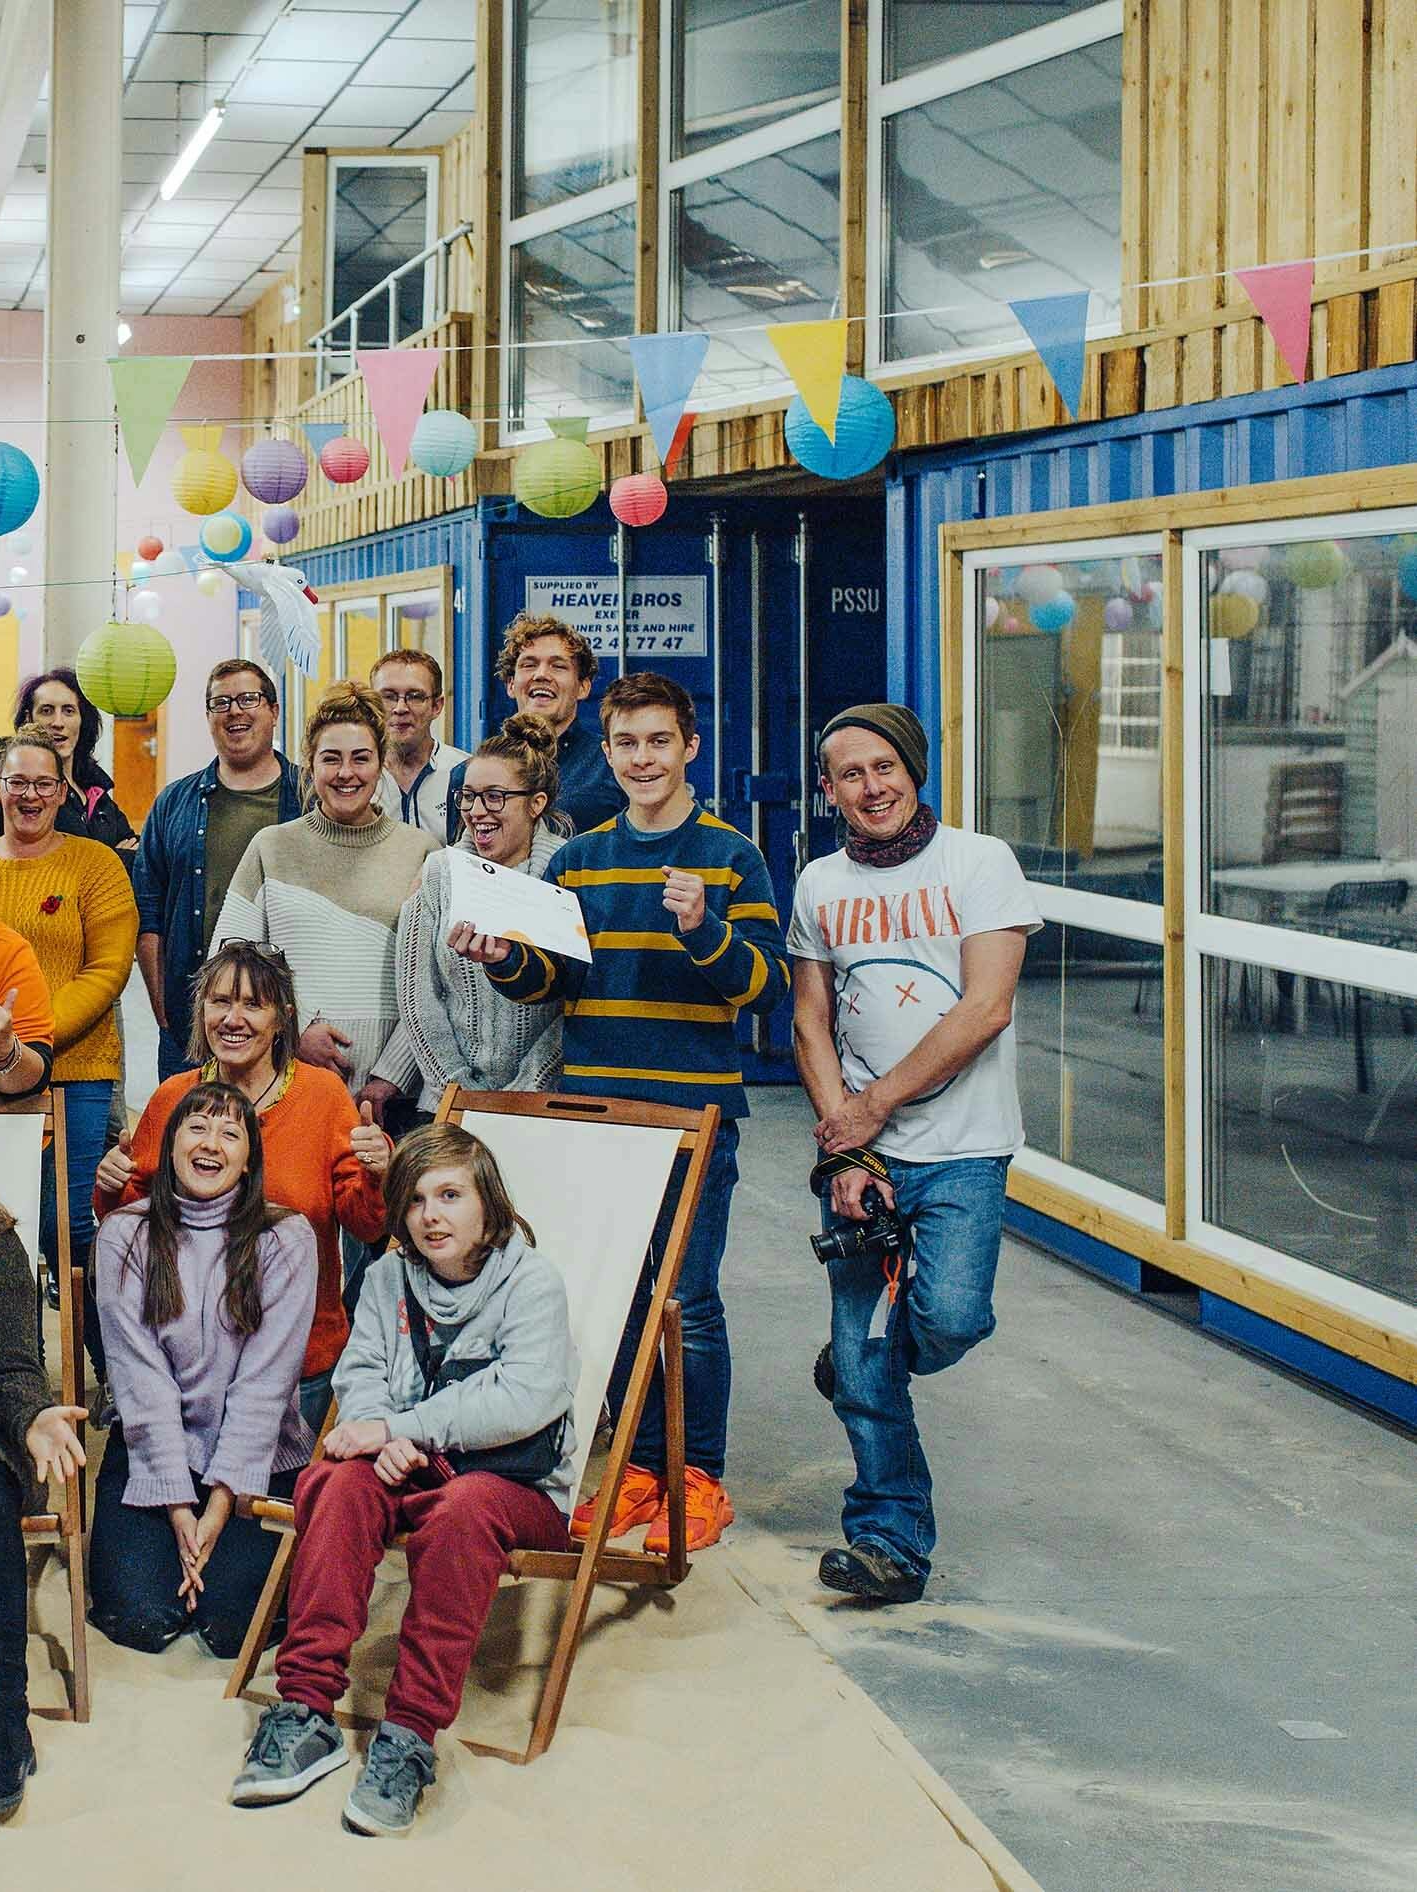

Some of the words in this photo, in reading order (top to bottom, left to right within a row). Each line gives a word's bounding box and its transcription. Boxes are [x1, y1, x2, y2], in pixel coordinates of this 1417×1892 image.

[533, 581, 582, 590] SUPPLIED
[585, 581, 598, 590] BY
[630, 593, 682, 607] BROS
[831, 587, 879, 613] PSSU
[594, 610, 639, 620] EXEER
[606, 624, 639, 633] SAES
[643, 624, 665, 633] AND
[669, 624, 695, 633] HIRE
[637, 637, 657, 650] 77
[663, 637, 683, 650] 47
[816, 885, 961, 950] NIRVANA
